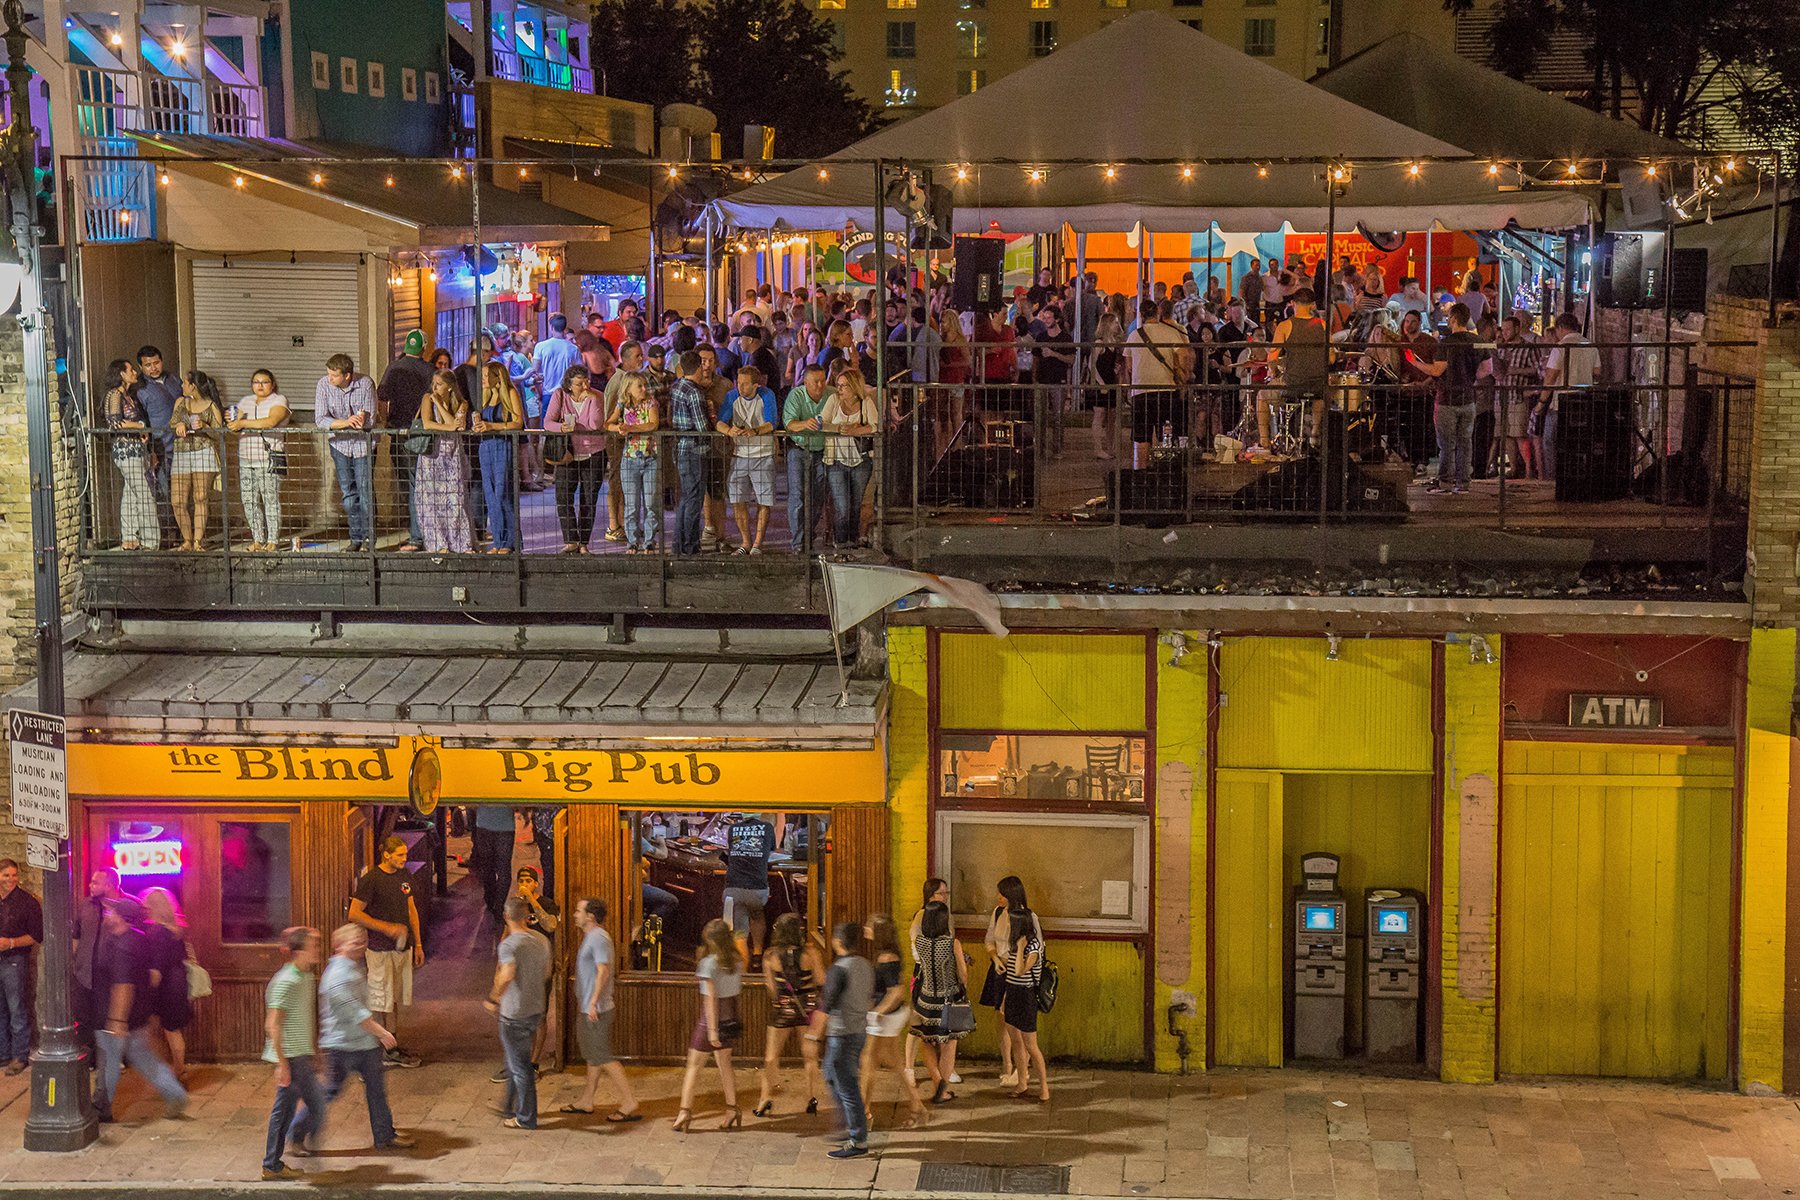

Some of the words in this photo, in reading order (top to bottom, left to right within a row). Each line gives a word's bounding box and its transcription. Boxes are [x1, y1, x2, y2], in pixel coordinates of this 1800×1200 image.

[840, 232, 874, 252] BLIND
[1581, 697, 1650, 726] ATM
[24, 716, 64, 734] RESTRICTED
[36, 731, 54, 745] LANE
[22, 746, 56, 763] MUSICIAN
[13, 763, 46, 779] LOADING
[50, 770, 64, 783] AND
[168, 747, 219, 766] the
[230, 746, 394, 782] Blind
[496, 750, 593, 793] Pig
[601, 750, 721, 786] Pub
[19, 782, 60, 800] UNLOADING
[14, 813, 36, 826] PERMIT
[39, 818, 66, 834] REQUIRED
[114, 845, 182, 868] OPEN
